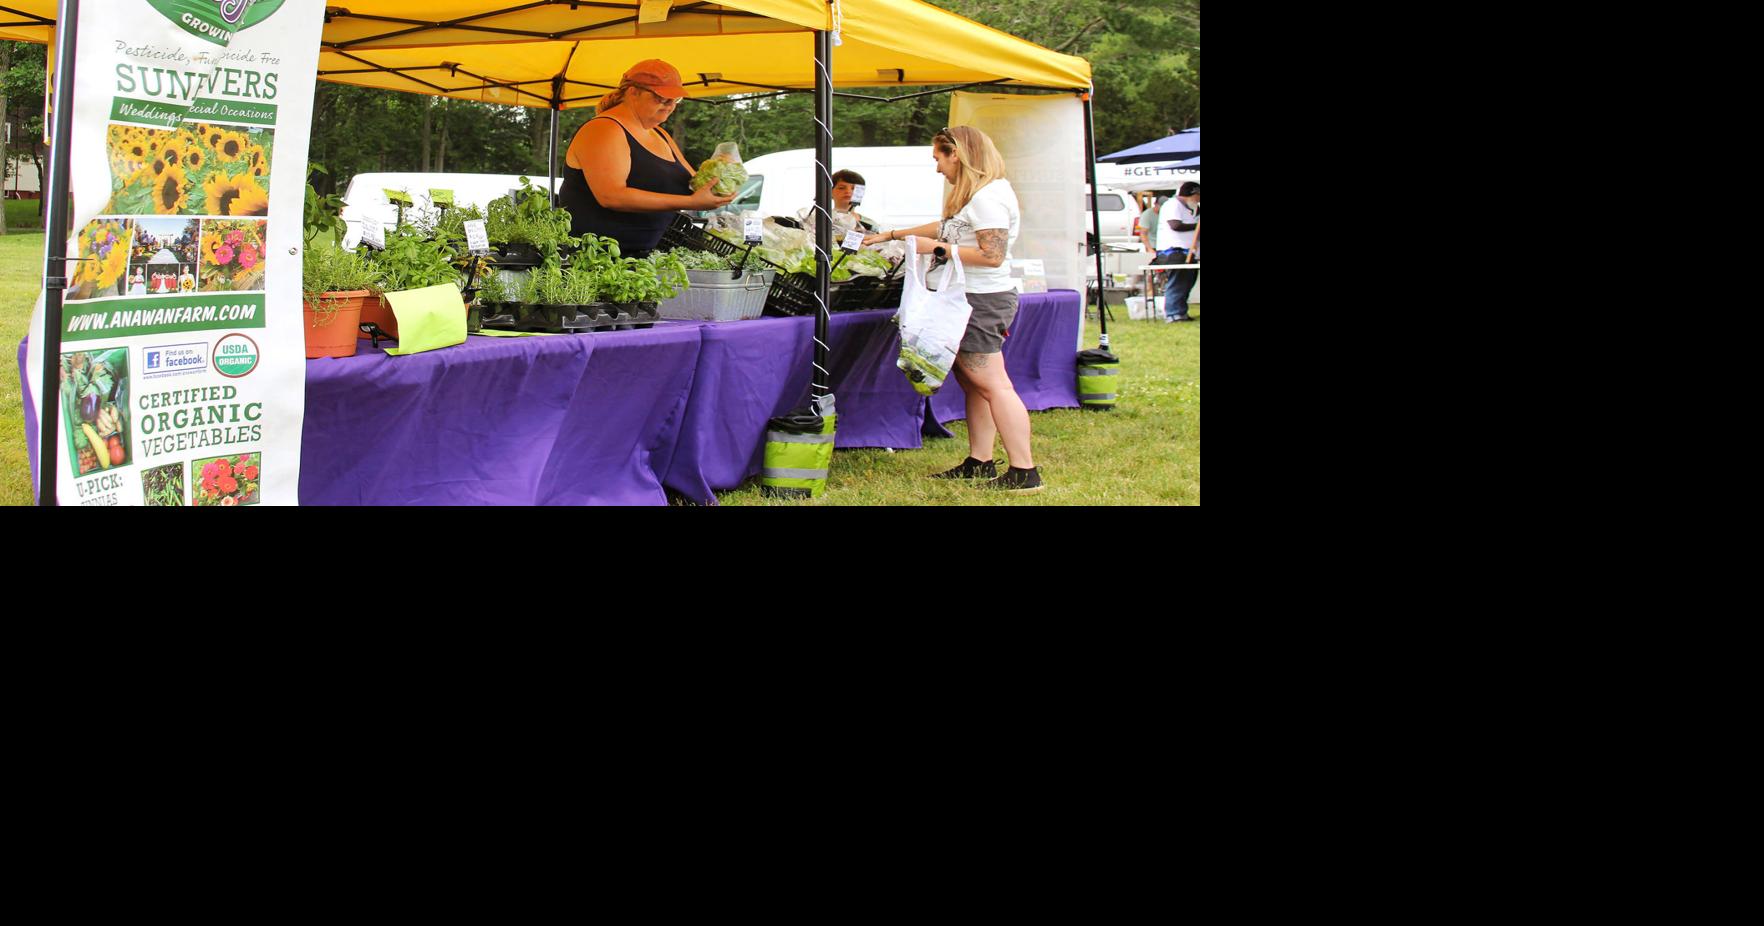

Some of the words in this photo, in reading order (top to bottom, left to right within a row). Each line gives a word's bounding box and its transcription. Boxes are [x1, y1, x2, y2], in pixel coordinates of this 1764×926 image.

[114, 39, 189, 66] Pesticide,
[260, 52, 281, 66] Free
[187, 102, 219, 115] ecial
[220, 105, 273, 120] Occasions
[1124, 166, 1161, 176] #GET
[67, 304, 257, 332] WWW.ANAWANFARM.COM
[219, 357, 252, 366] ORGANIC
[222, 344, 248, 354] USDA
[139, 385, 236, 410] CERTIFIED
[141, 402, 262, 435] ORGANIC
[141, 424, 262, 458] VEGETABLES
[76, 473, 124, 498] U-PICK:
